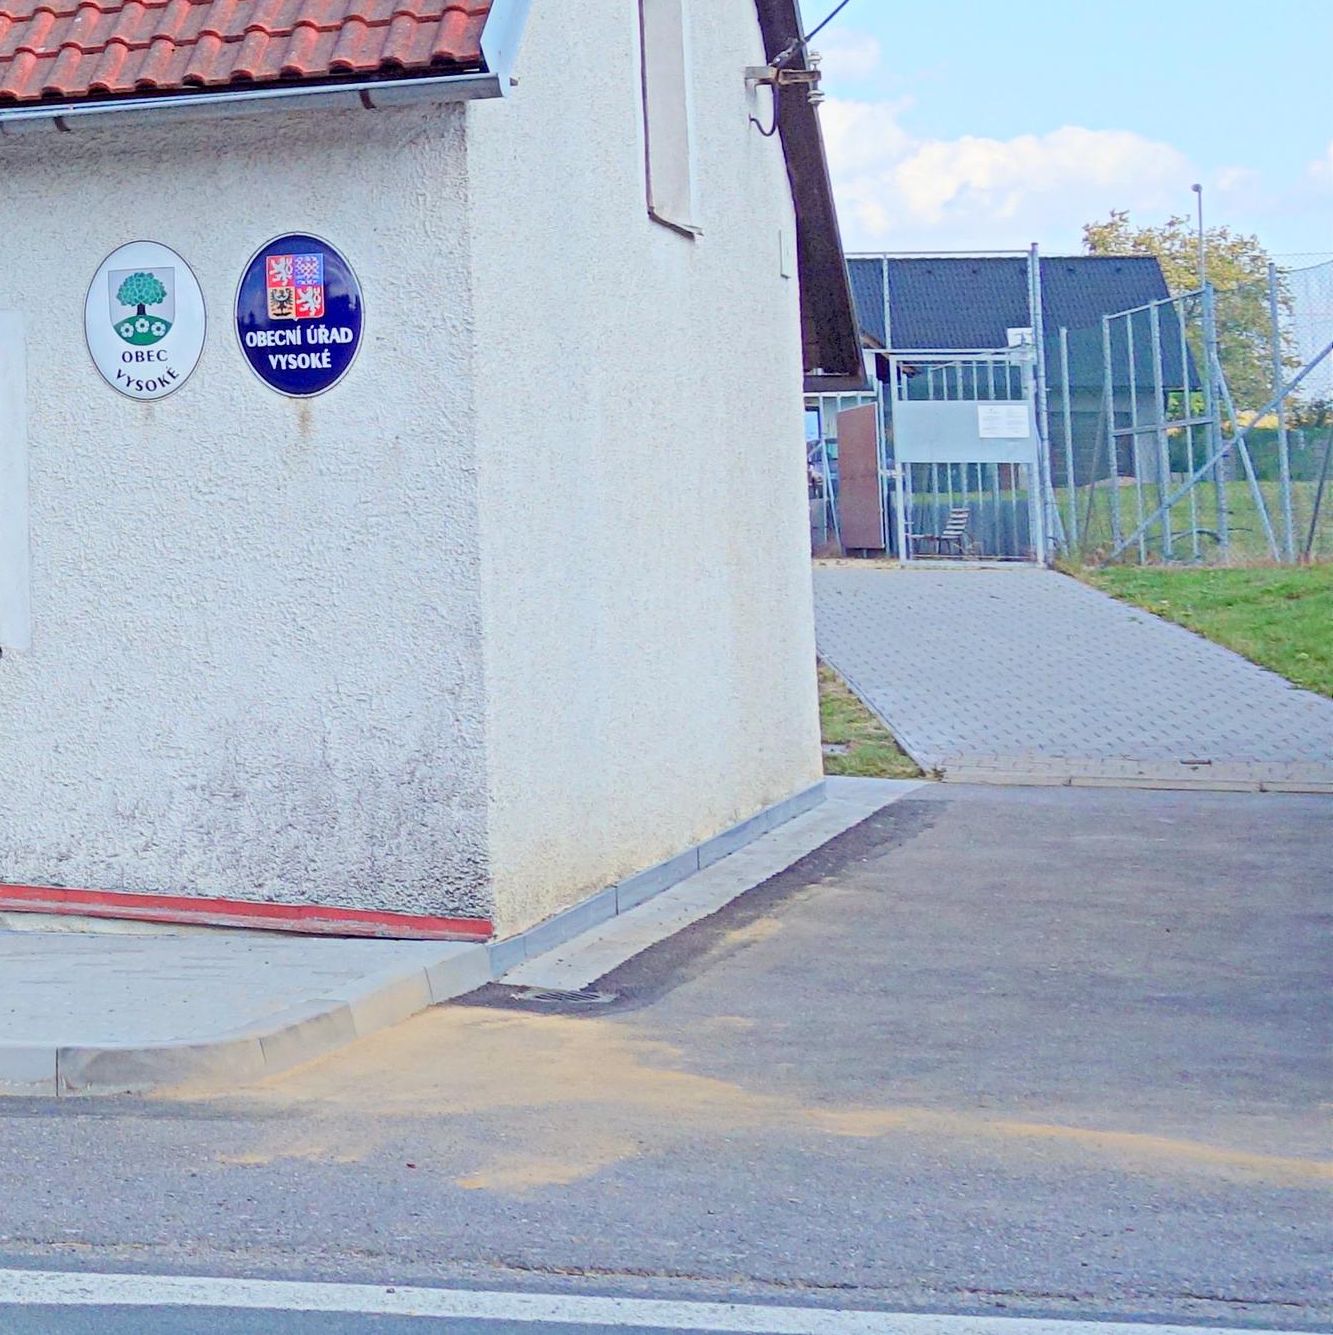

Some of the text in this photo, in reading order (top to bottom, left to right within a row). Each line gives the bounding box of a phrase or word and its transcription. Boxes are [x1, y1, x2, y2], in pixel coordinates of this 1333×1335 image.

[245, 324, 353, 347] OBECNÍ ÚŘAD
[121, 349, 168, 363] OBEC
[268, 348, 332, 370] VYSOKÉ
[116, 366, 180, 392] VYSOKÉ
